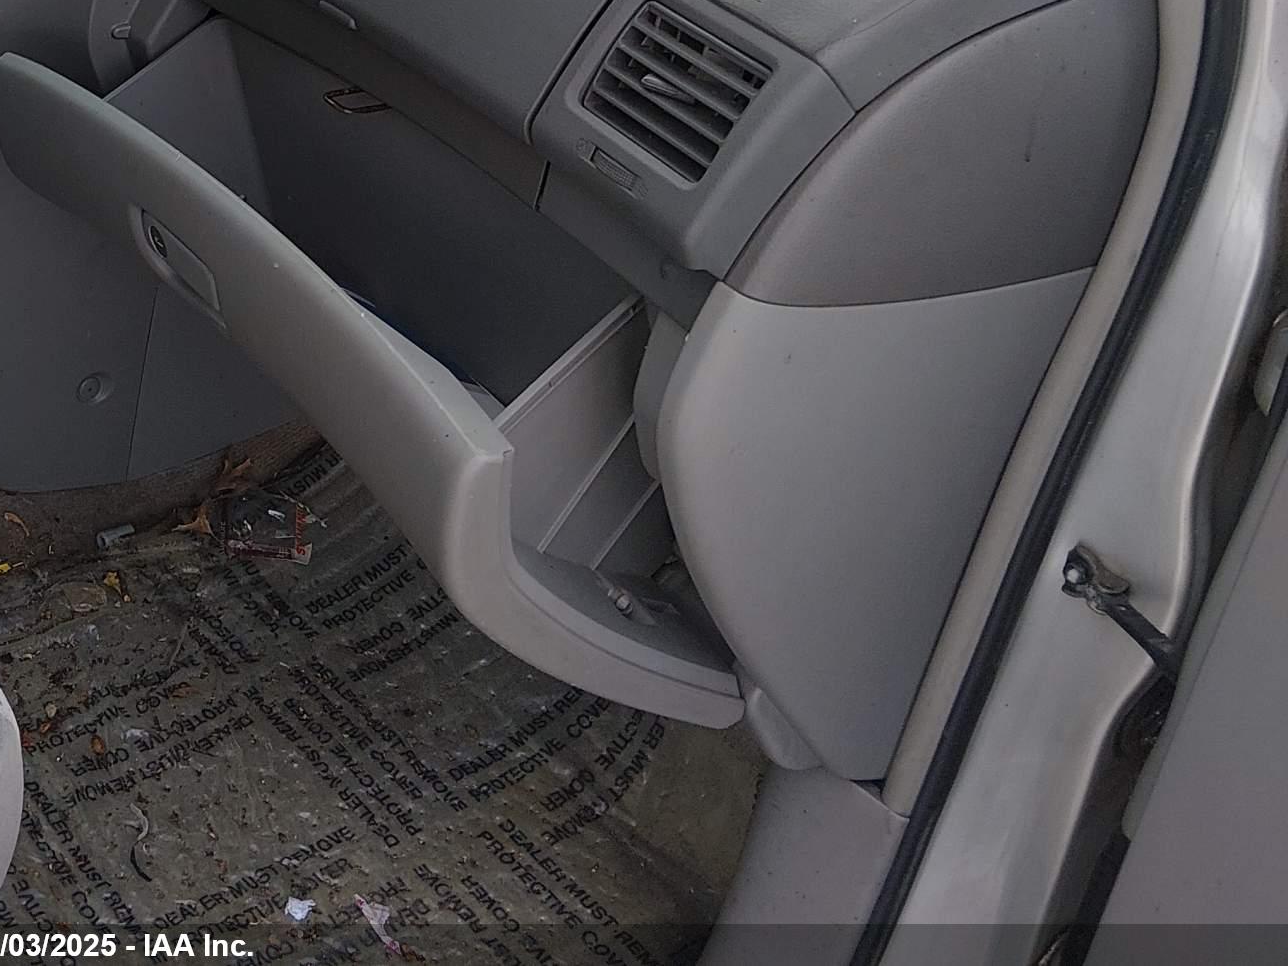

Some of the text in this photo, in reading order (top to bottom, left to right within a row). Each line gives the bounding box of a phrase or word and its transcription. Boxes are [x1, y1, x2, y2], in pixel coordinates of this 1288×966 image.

[305, 542, 410, 614] DEALER MUST
[322, 570, 415, 630] PROTECTIVE
[448, 706, 561, 783] DEALER MUST
[468, 736, 564, 802] PROTECTIVE
[565, 695, 612, 739] COVE
[25, 783, 74, 844] DEALER
[329, 744, 423, 834] PROTECTIVE
[337, 787, 401, 848] DEALER
[541, 769, 596, 813] COVER
[227, 863, 279, 900] MUST
[412, 863, 489, 935] REMOVE
[461, 874, 521, 934] COVER
[476, 829, 582, 931] PROTECTIVE
[497, 818, 567, 883] DEALER
[562, 880, 619, 934] MUST
